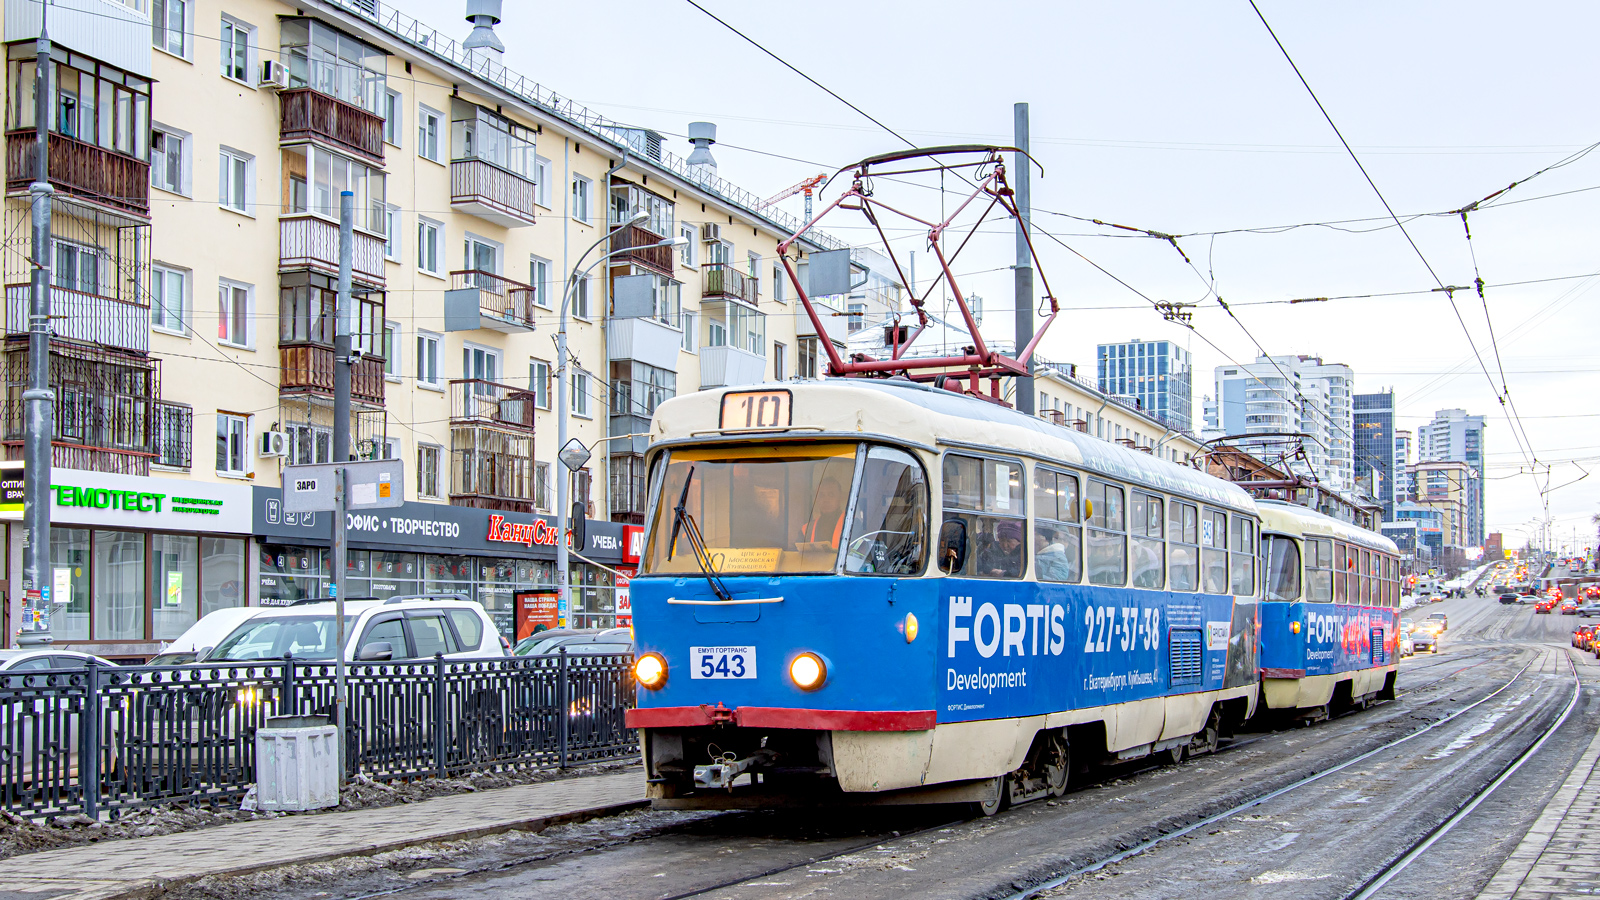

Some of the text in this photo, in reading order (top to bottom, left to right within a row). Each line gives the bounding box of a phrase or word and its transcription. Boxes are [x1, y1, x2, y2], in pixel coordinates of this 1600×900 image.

[742, 396, 780, 427] 10
[296, 480, 316, 491] ЗАРО
[391, 517, 460, 537] ТВОРЧЕСТВО
[592, 534, 617, 550] УЧЕБА
[948, 596, 1065, 658] FORTIS
[1084, 605, 1160, 653] 227-37-38
[701, 654, 746, 677] 543
[1307, 648, 1334, 662] Development
[947, 666, 1026, 694] Development
